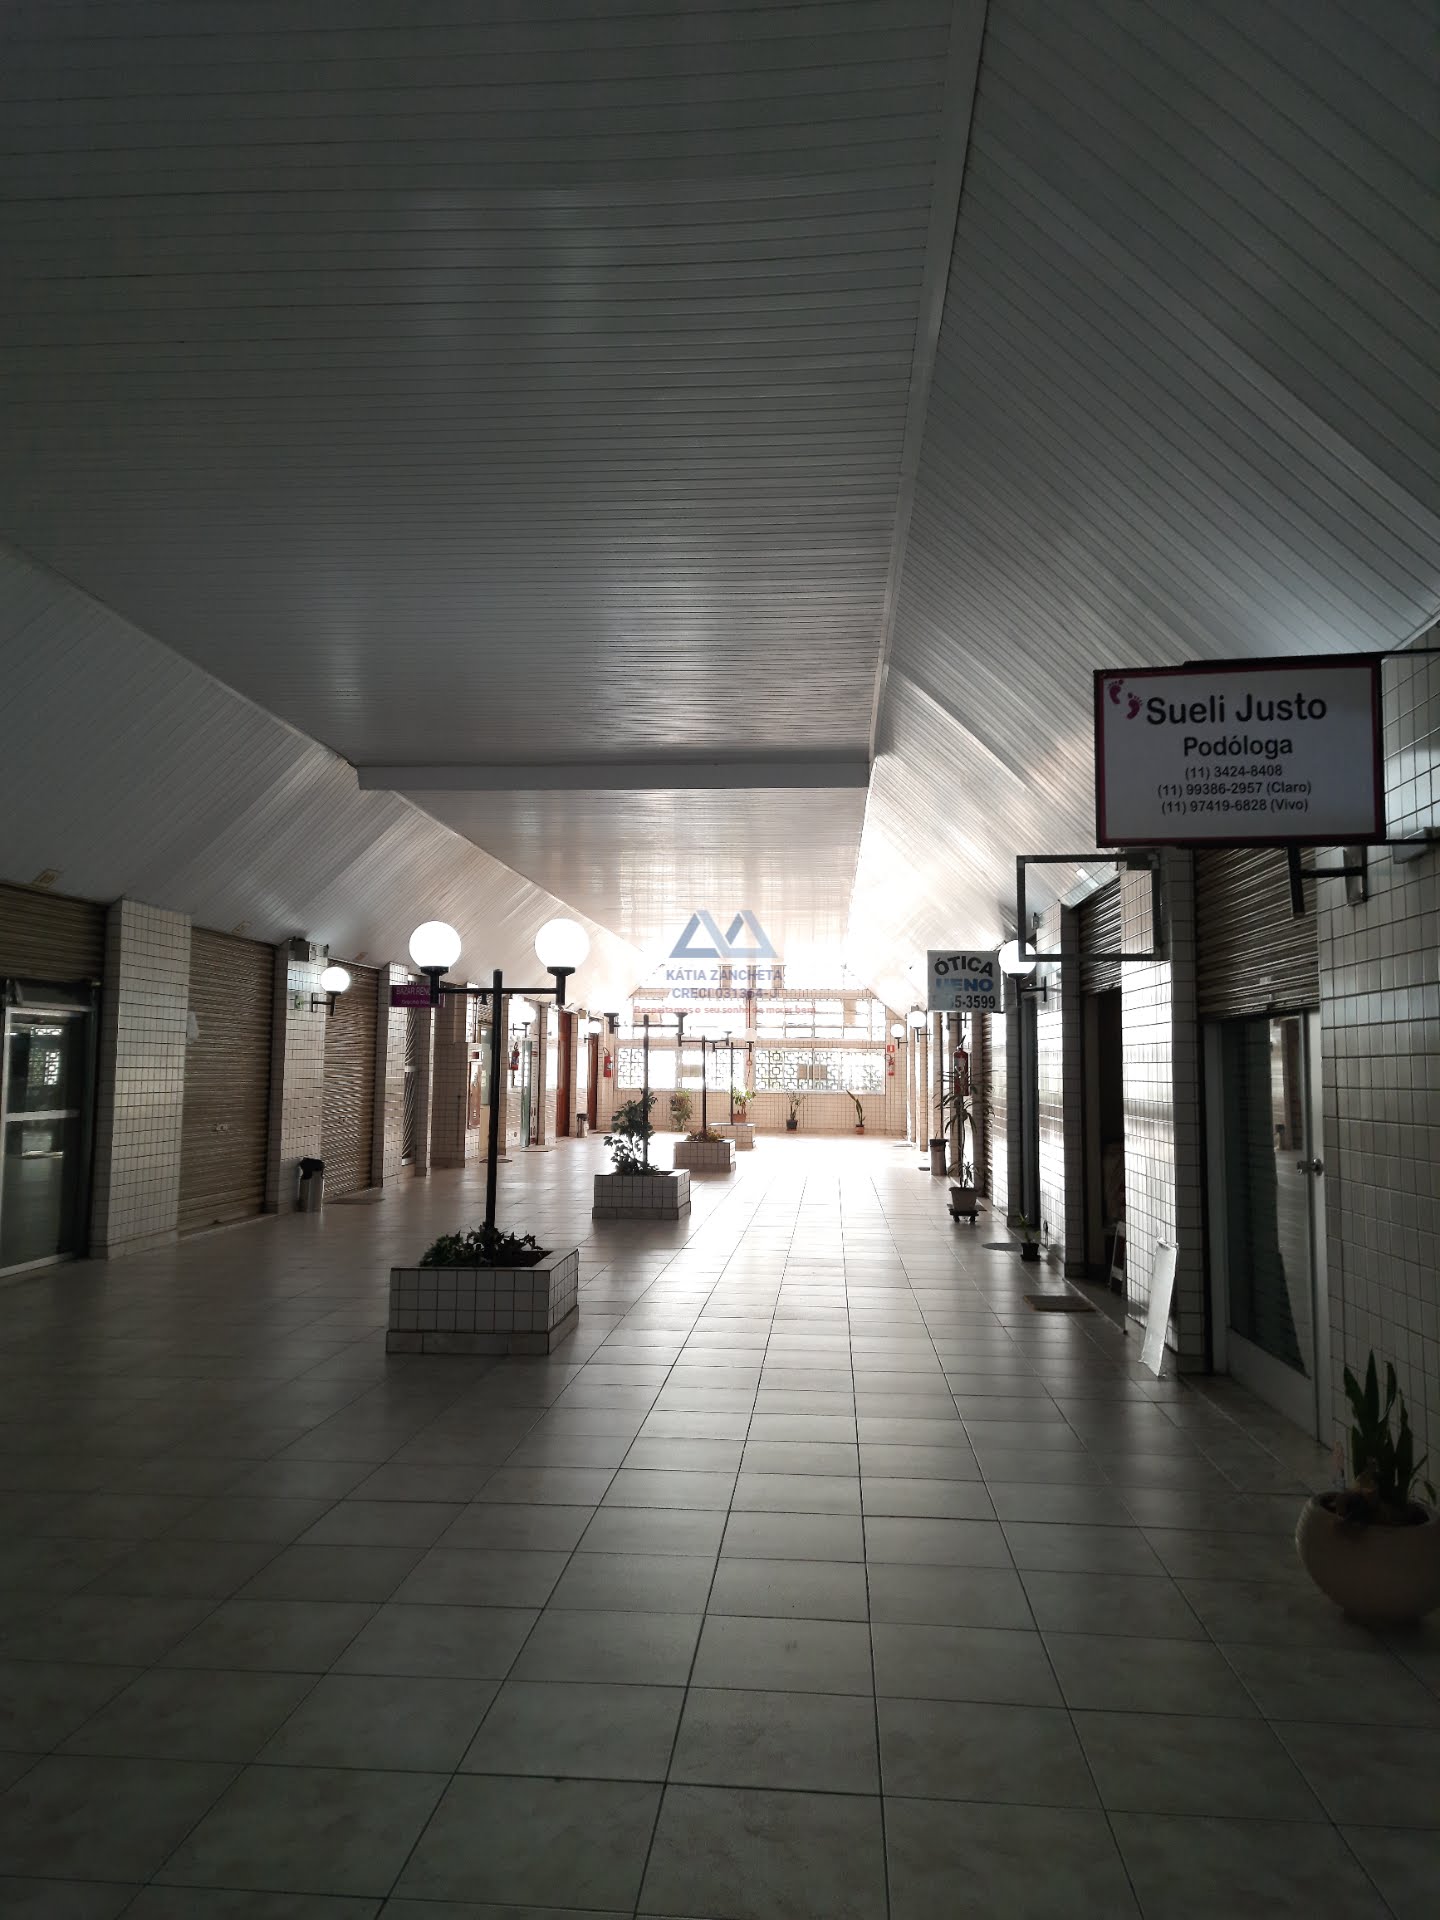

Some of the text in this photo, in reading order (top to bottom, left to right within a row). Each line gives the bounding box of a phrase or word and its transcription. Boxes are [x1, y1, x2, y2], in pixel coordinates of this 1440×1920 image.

[1146, 692, 1327, 725] Sueli Justo
[1183, 735, 1293, 760] Podóloga
[1185, 764, 1283, 780] (11) 3424-8408
[1157, 781, 1312, 798] (11) 99386-2957 (Claro)
[1161, 798, 1309, 815] (11) 97419-6828 (Vivo)
[934, 955, 993, 977] ÓTICA
